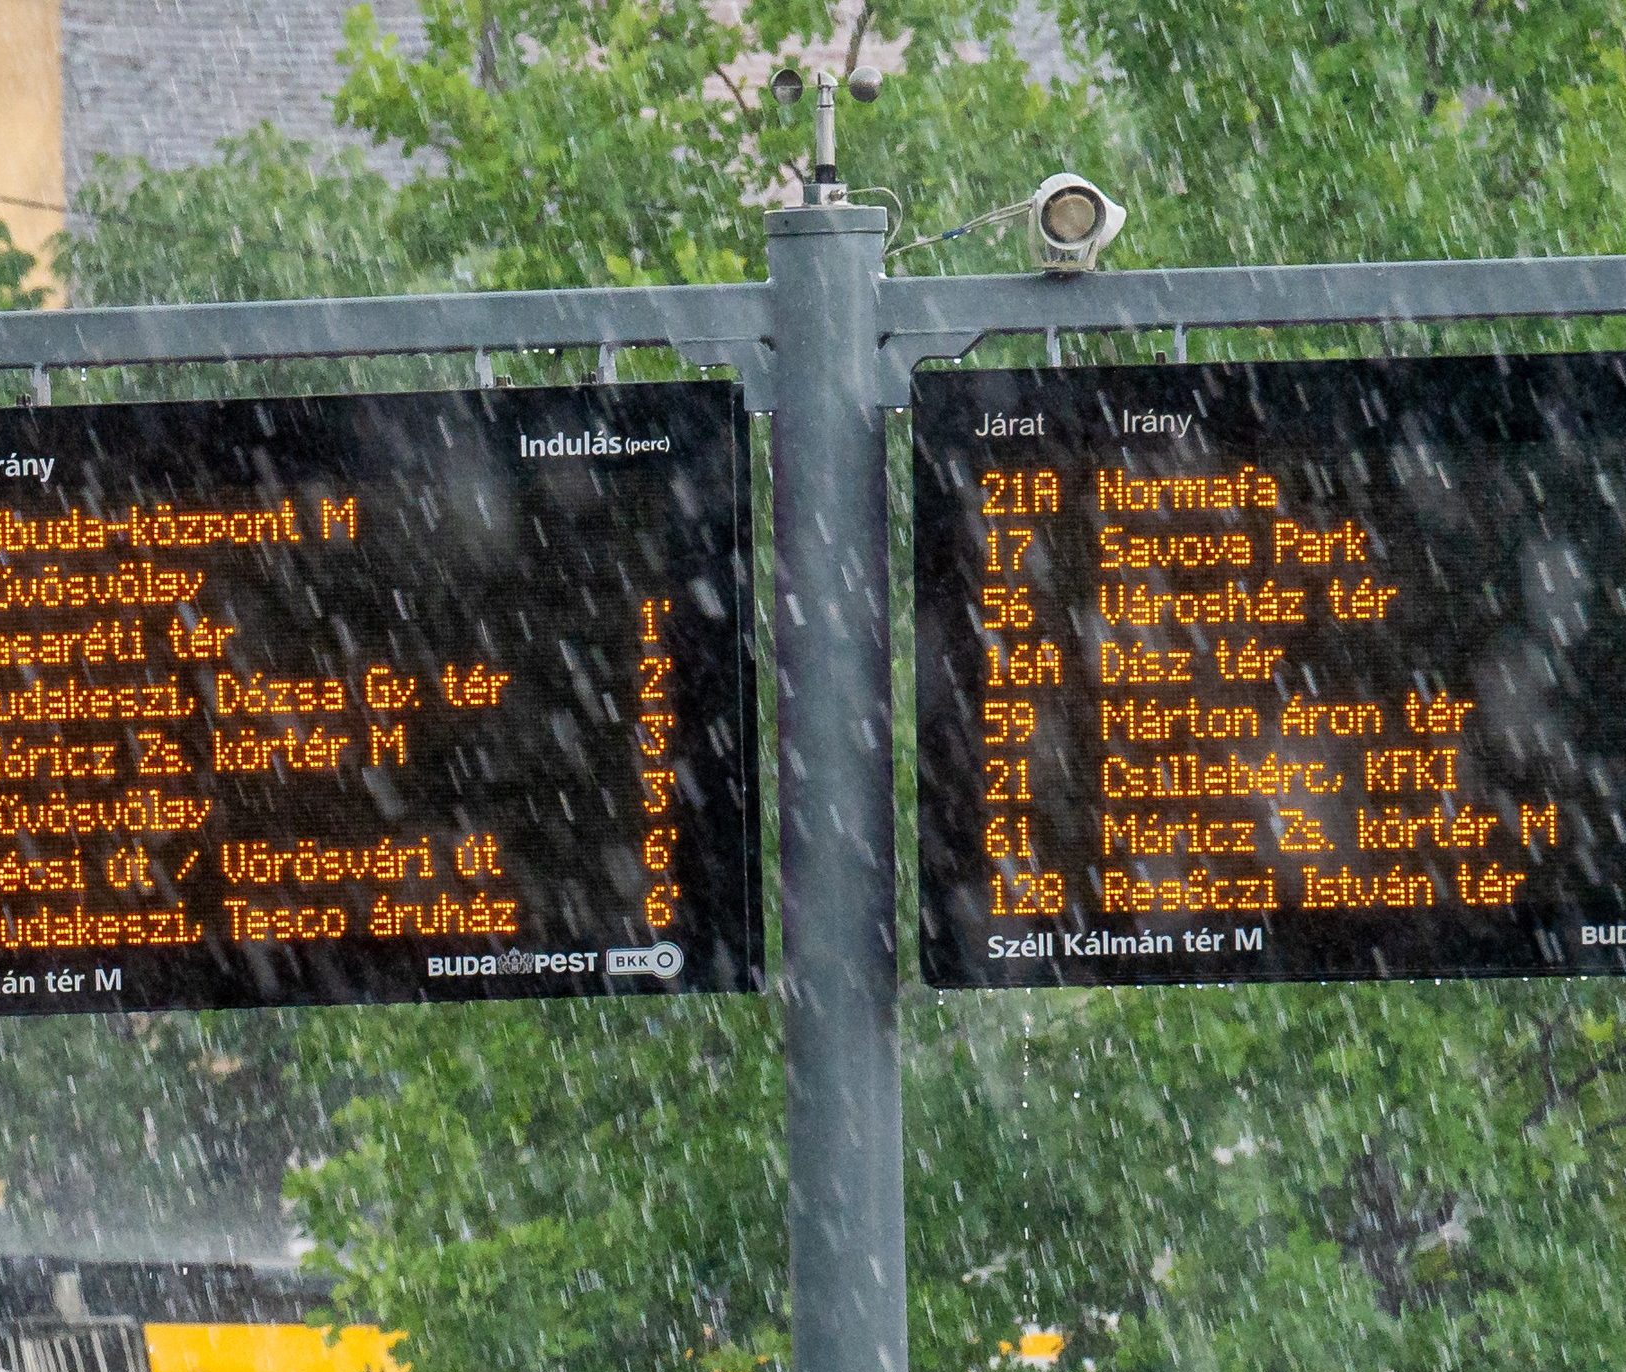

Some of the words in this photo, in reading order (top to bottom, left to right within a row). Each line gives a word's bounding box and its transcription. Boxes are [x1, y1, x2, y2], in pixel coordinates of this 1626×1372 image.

[520, 430, 622, 458] Indulás
[625, 435, 671, 456] (perc)
[974, 412, 1045, 437] Járat
[1123, 408, 1193, 439] Irány
[981, 471, 1058, 515] 21A
[1099, 466, 1278, 511] Normafa
[322, 497, 355, 539] M
[987, 530, 1032, 572] 17
[1100, 526, 1251, 568] Savoya
[1275, 521, 1365, 564] Park
[983, 587, 1033, 629] 56
[1099, 580, 1305, 626] Városház
[1329, 578, 1397, 619] tér
[168, 617, 234, 659] tér
[987, 642, 1060, 687] 16A
[1100, 641, 1191, 683] Dísz
[1215, 638, 1283, 680] tér
[214, 672, 344, 716] Dózsa
[442, 664, 509, 707] tér
[984, 702, 1036, 744] 59
[1102, 697, 1258, 741] Márton
[1282, 695, 1381, 736] Áron
[1405, 691, 1473, 733] tér
[137, 733, 192, 775] Zs.
[215, 727, 348, 771] körtér
[371, 724, 404, 766] M
[986, 759, 1031, 801] 21
[1103, 752, 1342, 798] Csillebérc,
[1366, 749, 1457, 791] KFKI
[986, 816, 1032, 858] 61
[1104, 812, 1255, 855] Móricz
[1278, 808, 1335, 852] Zs.
[1358, 805, 1497, 849] körtér
[1522, 804, 1556, 845] M
[106, 846, 153, 889] út
[222, 837, 433, 884] Vörösvári
[457, 835, 502, 876] út
[991, 873, 1064, 915] 128
[1104, 868, 1278, 912] Regőczi
[1302, 865, 1433, 908] István
[1457, 863, 1525, 904] tér
[224, 900, 346, 940] Tesco
[369, 892, 516, 936] áruház
[615, 955, 648, 968] BKK
[987, 932, 1054, 959] Széll
[1063, 930, 1173, 957] Kálmán
[1182, 927, 1225, 954] tér
[1234, 926, 1263, 952] M
[44, 968, 86, 994] tér
[95, 967, 123, 992] M
